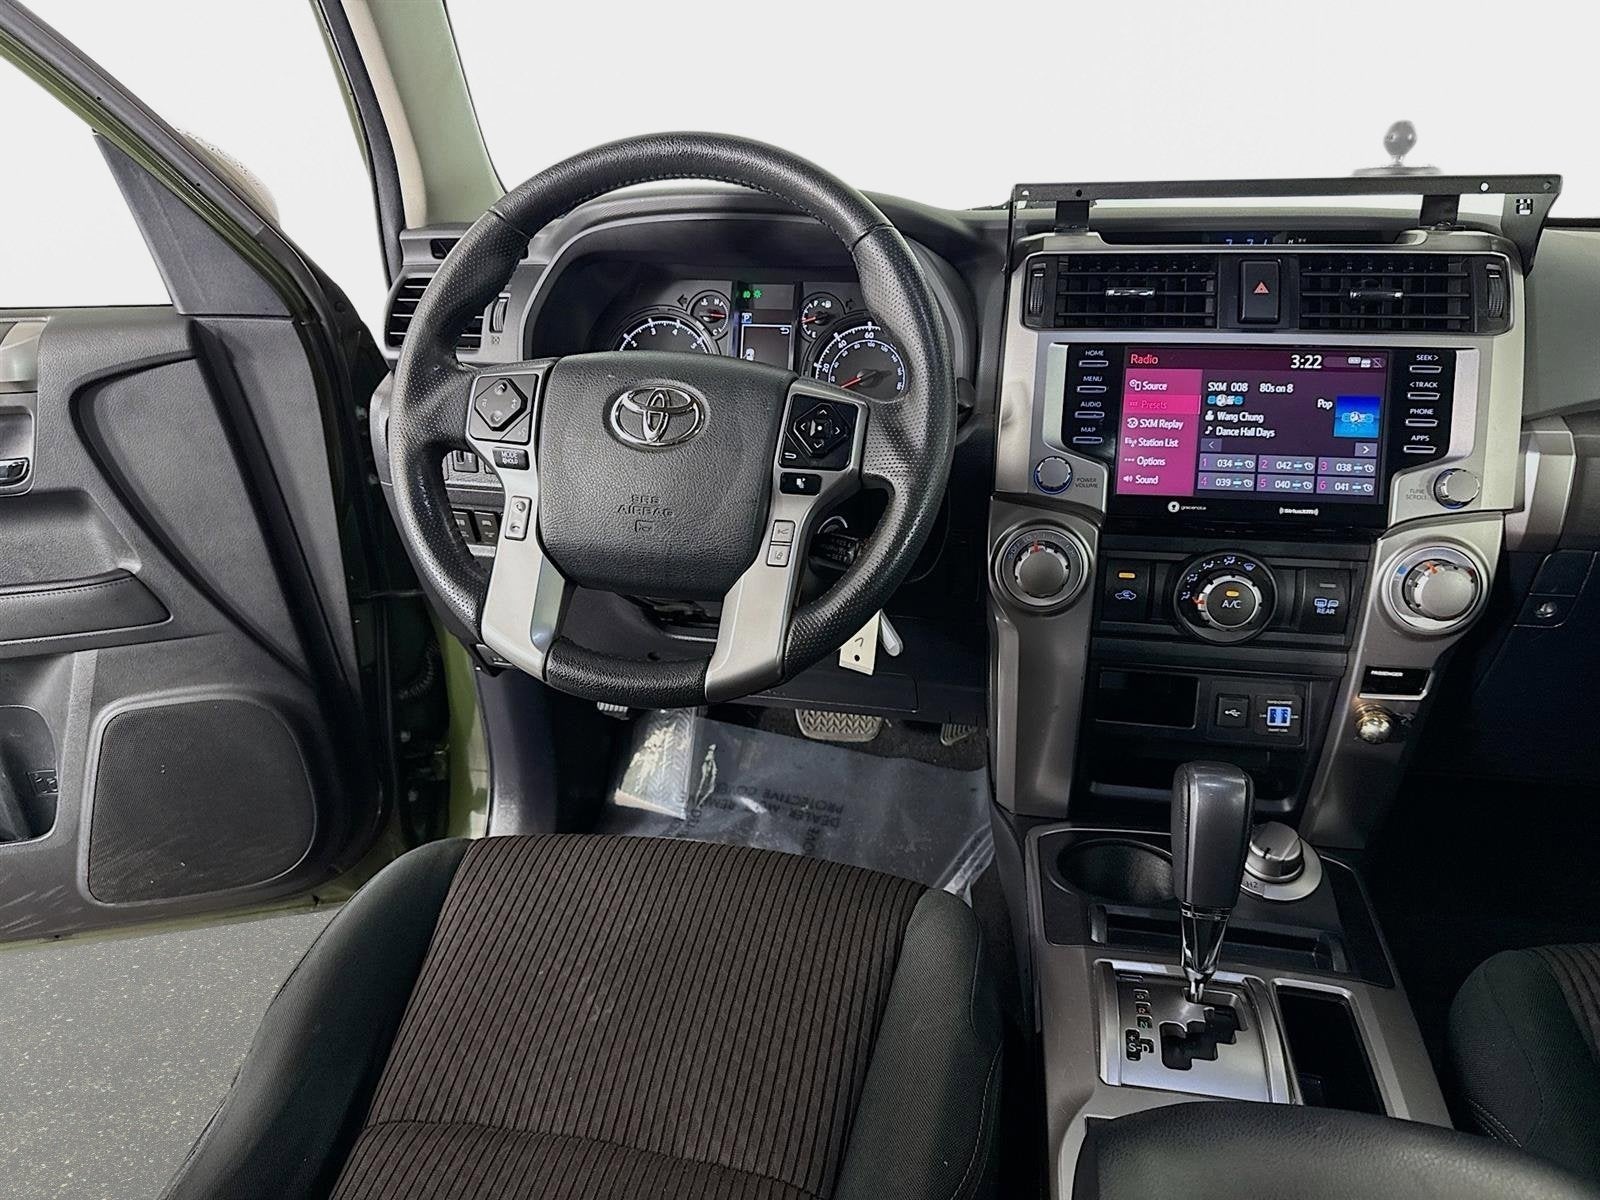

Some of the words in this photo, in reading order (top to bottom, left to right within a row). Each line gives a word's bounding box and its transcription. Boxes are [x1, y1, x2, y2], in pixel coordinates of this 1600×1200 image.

[650, 327, 656, 336] 3
[672, 328, 679, 336] 4
[864, 331, 874, 339] 60
[838, 340, 847, 349] 40
[1085, 349, 1104, 357] HOME
[1130, 353, 1159, 365] Radio
[1290, 354, 1323, 370] 3:22
[822, 363, 830, 373] 20
[1142, 380, 1168, 391] Source
[1207, 382, 1228, 392] SXM
[1230, 382, 1249, 392] 008
[1259, 383, 1275, 393] 80s
[1275, 385, 1286, 393] on
[1286, 384, 1294, 393] 8
[1415, 381, 1439, 389] TRACK
[1141, 400, 1167, 410] Presets
[1317, 398, 1333, 410] Pop
[1217, 412, 1238, 423] Wang
[1239, 413, 1264, 424] Chung
[1139, 419, 1159, 429] SXM
[1159, 420, 1184, 431] Replay
[1215, 426, 1240, 437] Dance
[1240, 427, 1255, 437] Hall
[1255, 428, 1276, 438] Days
[1138, 438, 1164, 448] Station
[1164, 438, 1179, 448] List
[1410, 434, 1430, 442] APPS
[501, 450, 518, 458] MODE
[1136, 456, 1166, 467] Options
[1202, 457, 1207, 467] 1
[1217, 458, 1233, 468] 034
[1261, 459, 1268, 469] 2
[1276, 460, 1292, 470] 042
[1320, 461, 1328, 471] 3
[1335, 463, 1352, 472] 038
[1135, 475, 1159, 485] Sound
[1200, 476, 1208, 486] 4
[1215, 478, 1231, 487] 039
[1259, 478, 1267, 488] 5
[1274, 480, 1291, 489] 040
[1319, 480, 1326, 490] 6
[1334, 482, 1350, 491] 041
[1221, 600, 1242, 609] A/C
[1316, 607, 1336, 615] REAR
[763, 788, 844, 815] PROTECTIVE
[788, 808, 841, 830] DEALER
[1140, 1021, 1148, 1029] N
